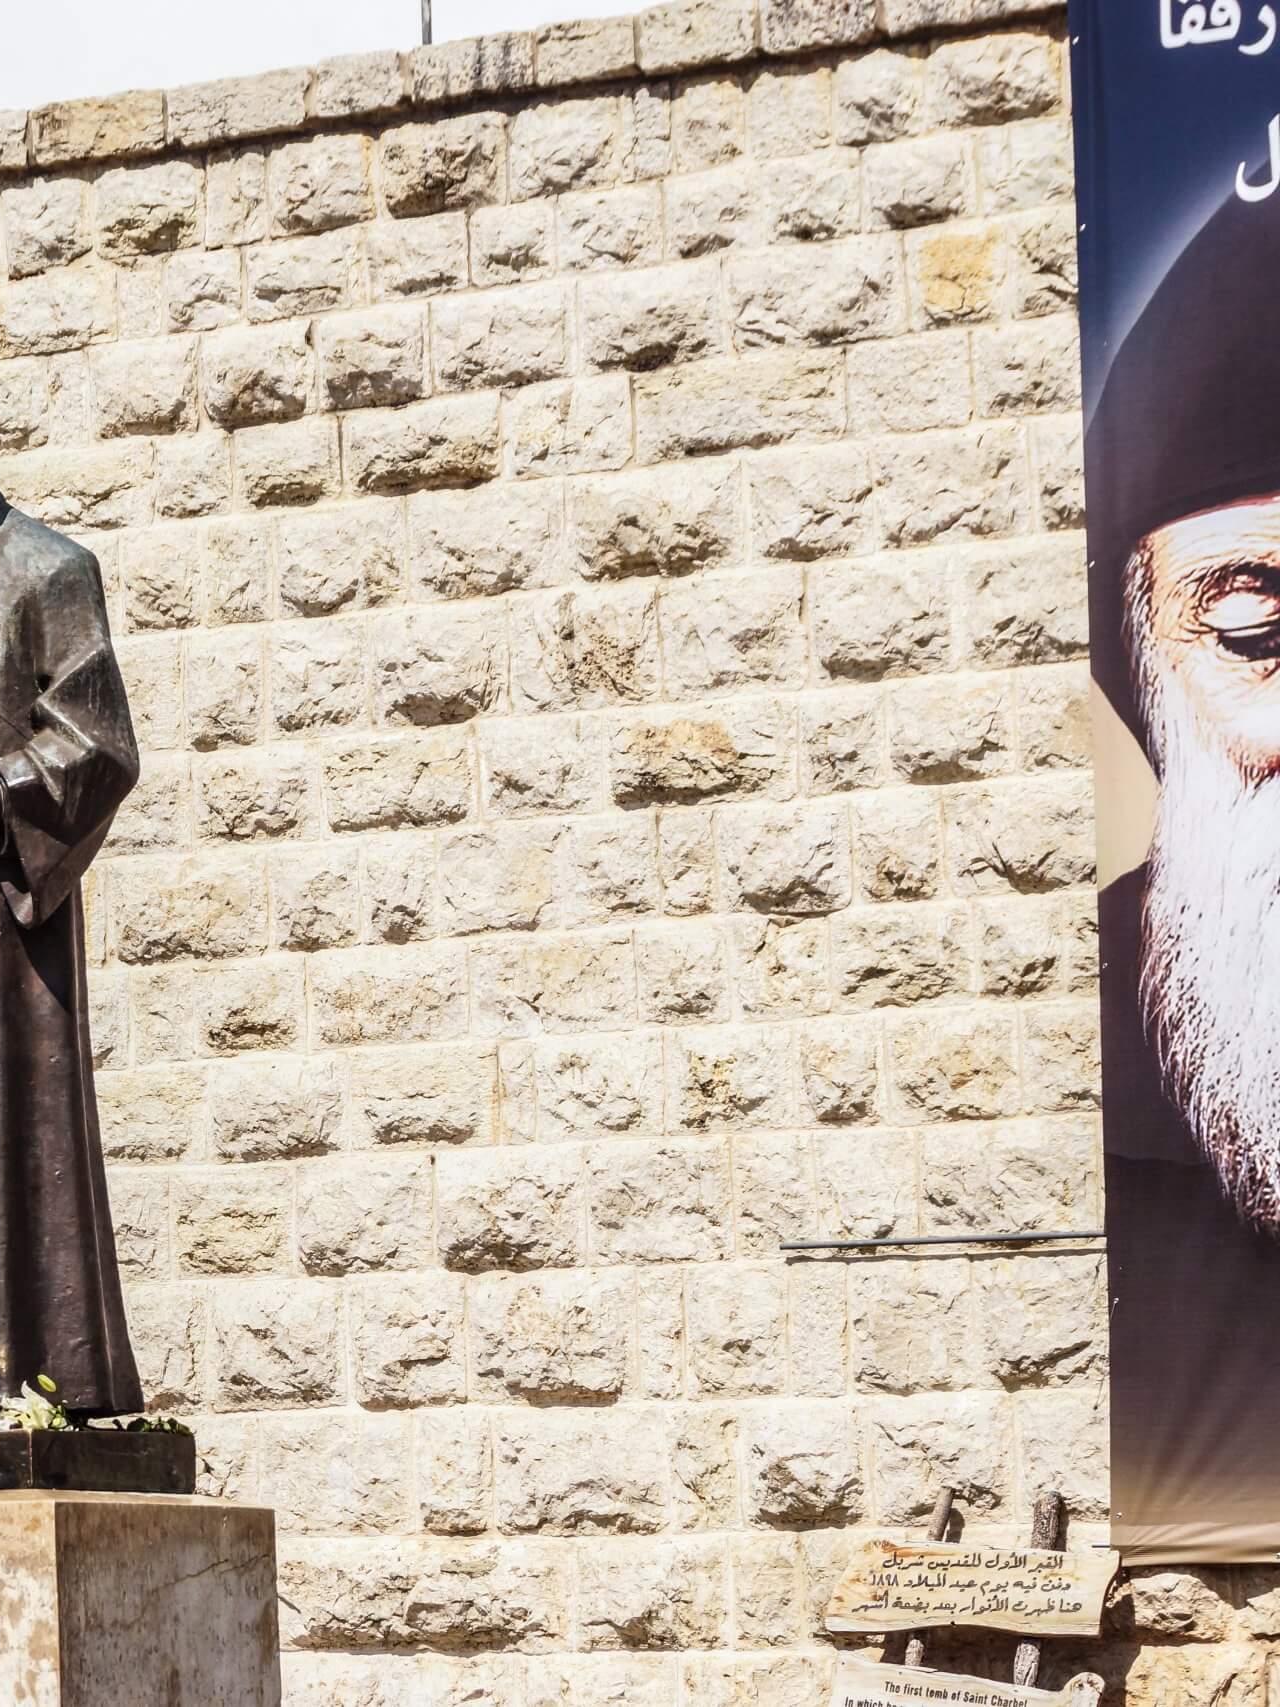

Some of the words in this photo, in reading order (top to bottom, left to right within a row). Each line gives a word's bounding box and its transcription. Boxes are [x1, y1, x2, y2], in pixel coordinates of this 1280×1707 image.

[882, 1551, 924, 1570] شربل
[927, 1553, 981, 1571] للقديس
[985, 1552, 1027, 1570] الأول
[1028, 1554, 1063, 1573] القبر
[904, 1573, 946, 1591] الميلاد
[949, 1579, 977, 1592] عيد
[980, 1580, 1009, 1596] يوم
[1013, 1577, 1038, 1593] فيه
[1041, 1577, 1072, 1592] دفن
[892, 1597, 930, 1613] بضعة
[933, 1602, 957, 1614] بعد
[959, 1595, 1008, 1615] الأنوار
[1012, 1598, 1056, 1616] ظهرت
[1059, 1598, 1083, 1613] هنا
[845, 1696, 853, 1707] In
[885, 1681, 900, 1693] The
[903, 1684, 923, 1697] first
[951, 1690, 961, 1701] of
[963, 1691, 988, 1705] Saint
[991, 1695, 1027, 1707] Charbel
